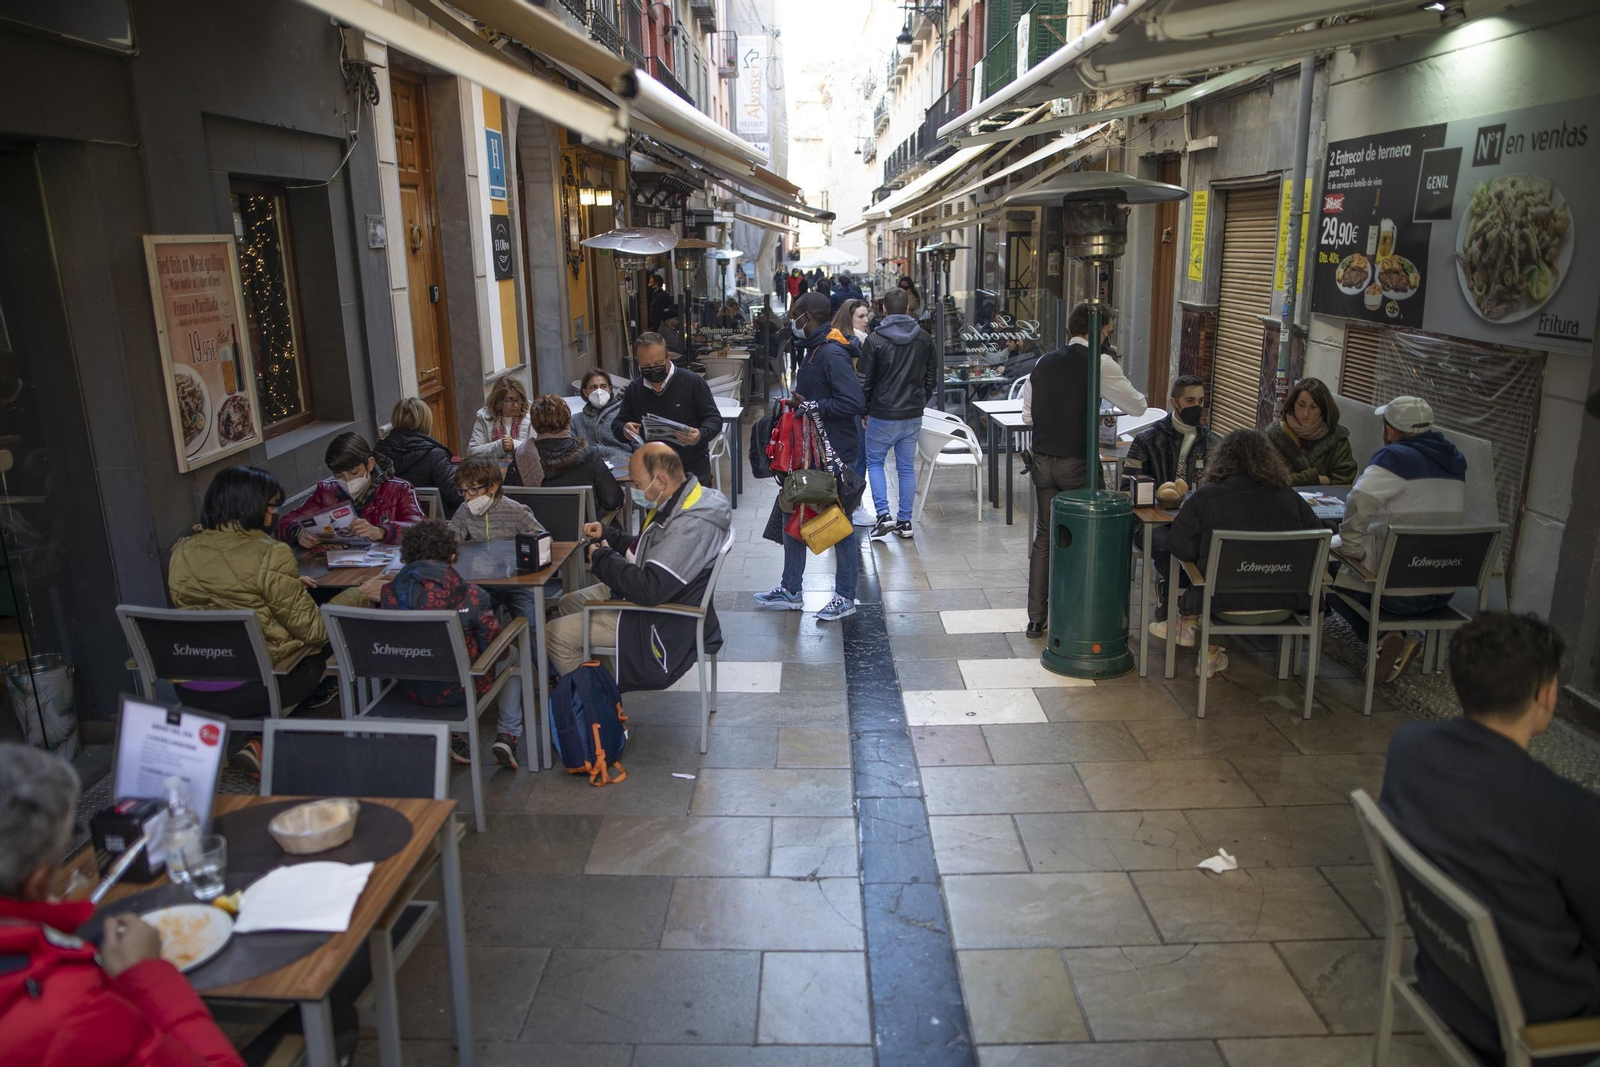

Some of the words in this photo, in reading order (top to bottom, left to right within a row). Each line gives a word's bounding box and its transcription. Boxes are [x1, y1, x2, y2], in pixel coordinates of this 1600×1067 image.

[743, 64, 760, 119] Alvaser
[1505, 134, 1525, 155] en
[1532, 120, 1588, 151] ventas
[490, 138, 500, 169] H
[1329, 151, 1335, 166] 2
[1335, 148, 1365, 166] Entrecot
[1365, 143, 1376, 161] de
[1378, 145, 1412, 160] ternera
[1328, 169, 1340, 181] para
[1340, 166, 1345, 177] 2
[1344, 167, 1356, 179] pers
[1367, 177, 1373, 186] de
[1373, 177, 1383, 186] vino
[1426, 175, 1449, 190] GENIL
[1321, 217, 1359, 249] 29,90€
[170, 254, 182, 274] fish
[189, 254, 205, 273] Meat
[205, 253, 225, 274] grilling
[1328, 252, 1340, 264] 40%
[173, 301, 192, 317] Fritura
[195, 297, 219, 314] Parrillada
[699, 326, 733, 334] Alhambra
[1539, 313, 1579, 335] Fritura
[812, 412, 824, 434] BIMBA
[1237, 560, 1291, 574] Schweppes
[1406, 556, 1462, 569] Schweppes
[173, 643, 234, 659] Schweppes
[372, 642, 432, 658] Schweppes
